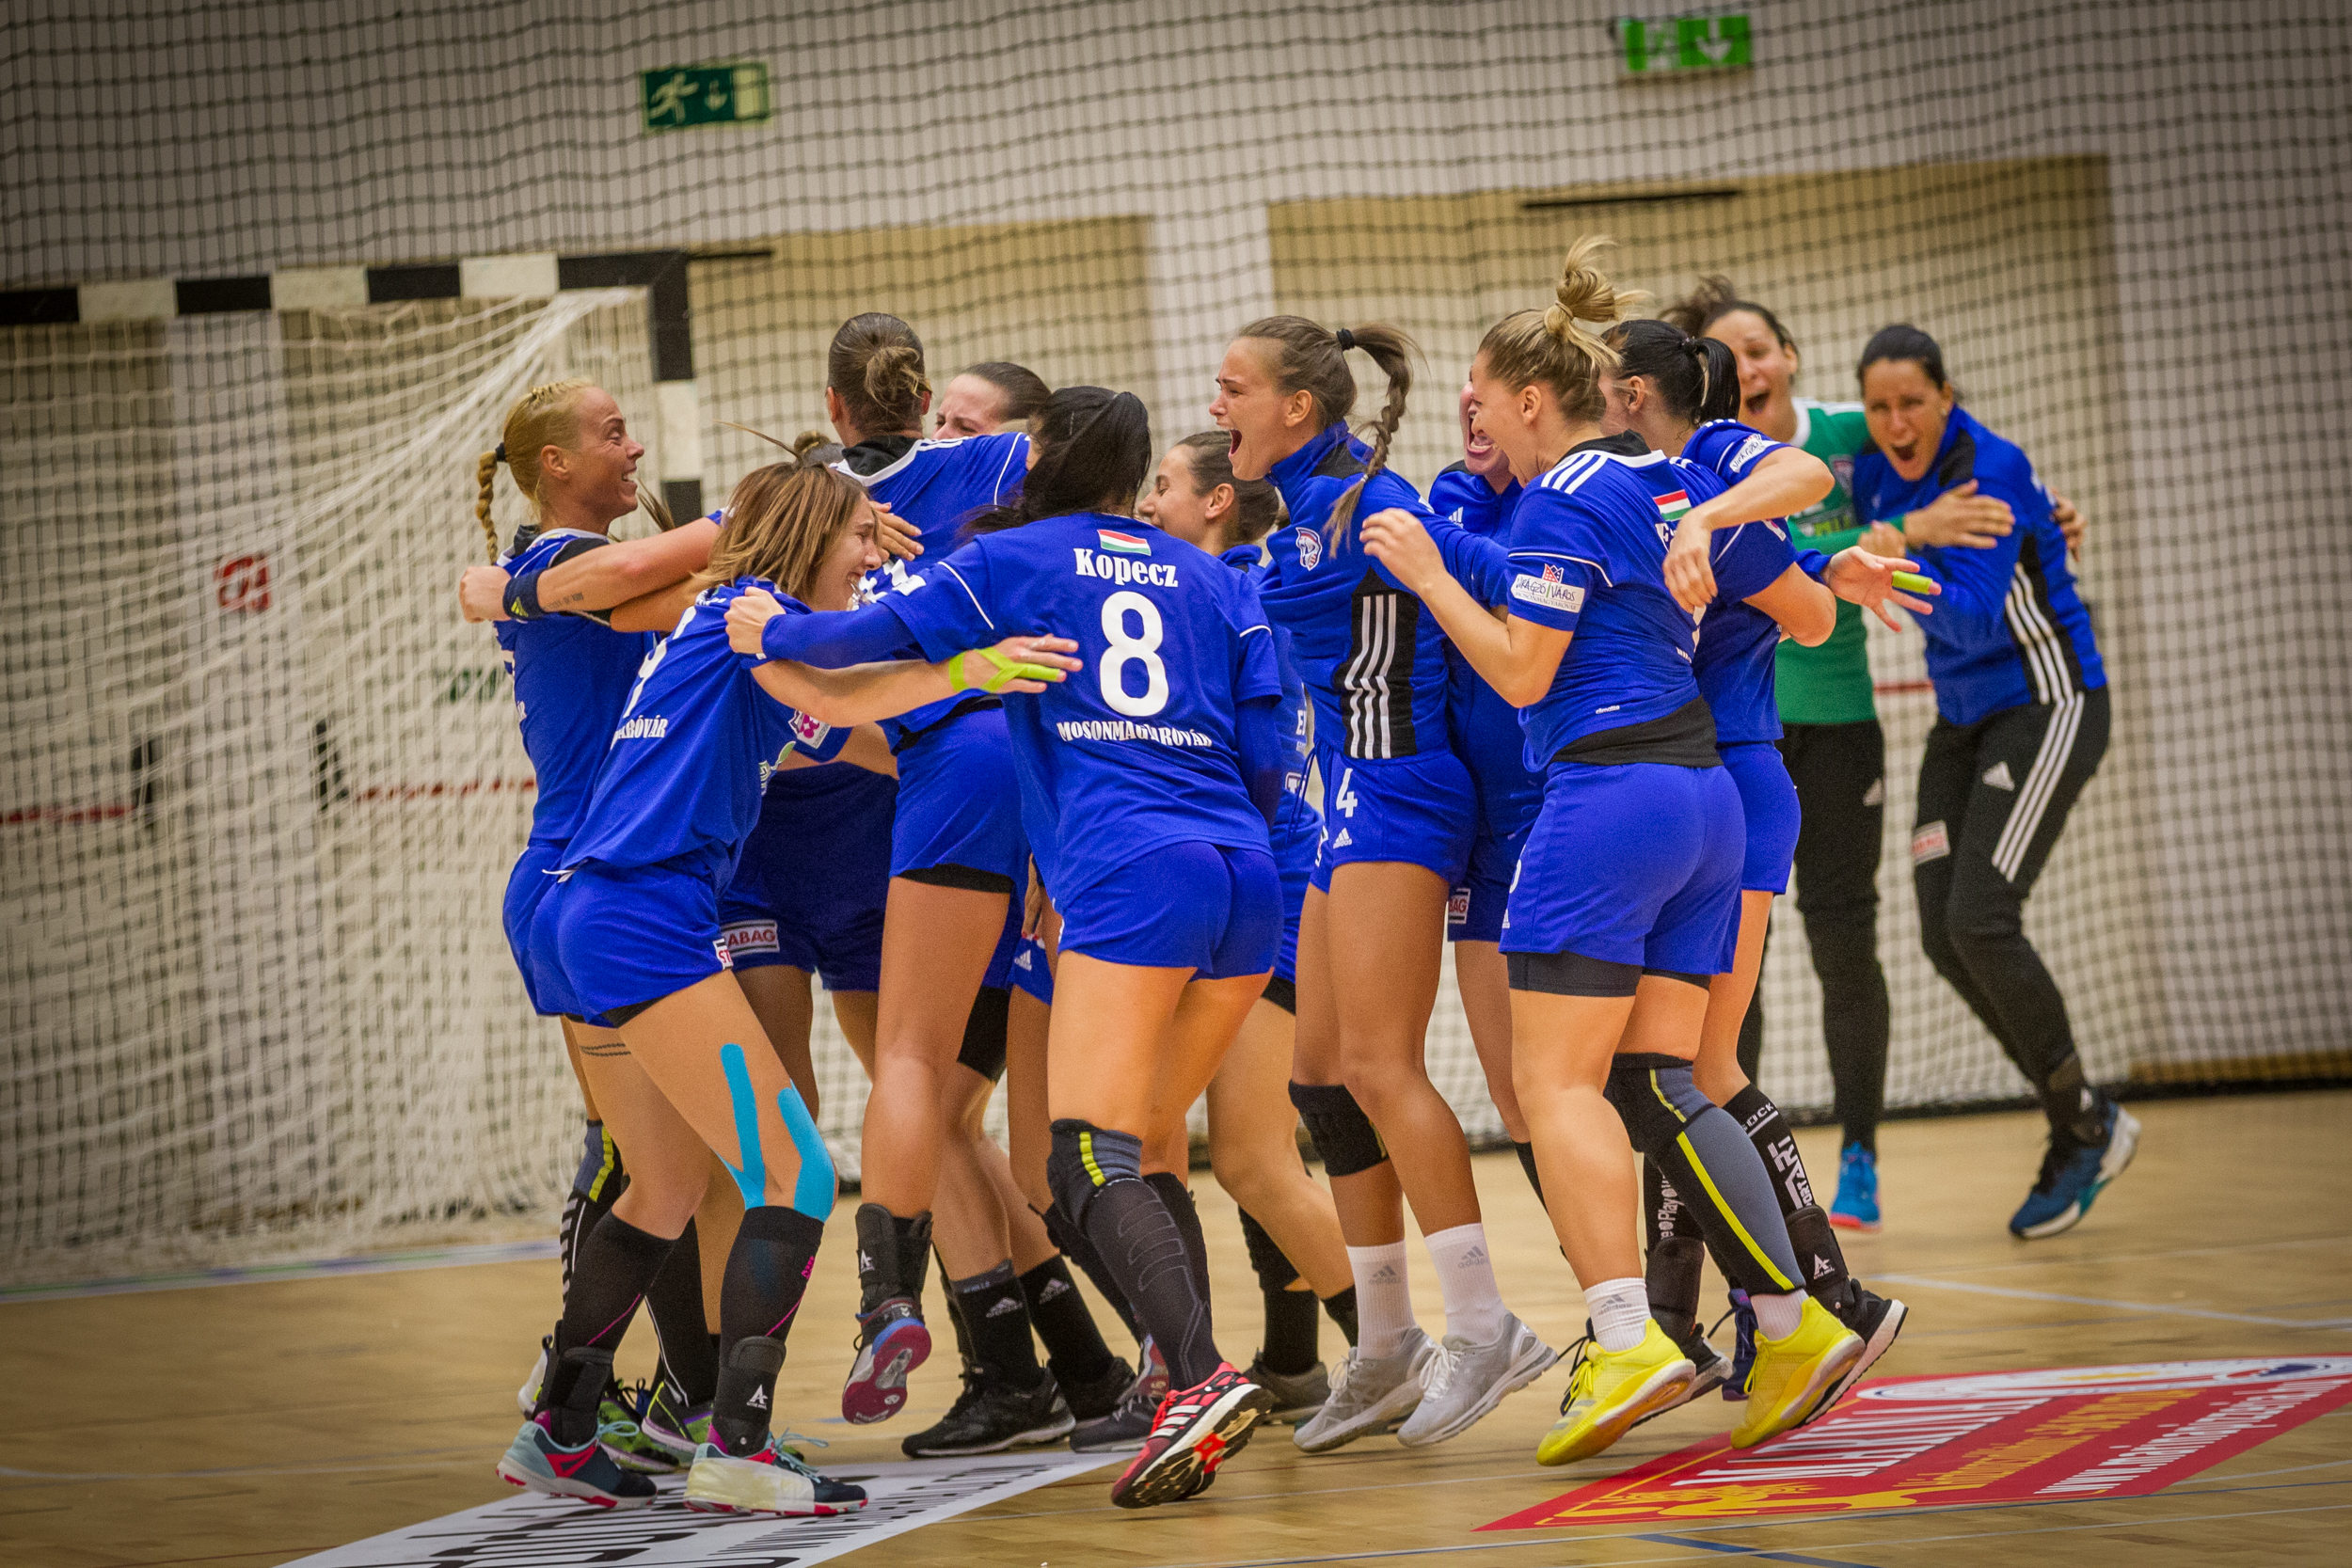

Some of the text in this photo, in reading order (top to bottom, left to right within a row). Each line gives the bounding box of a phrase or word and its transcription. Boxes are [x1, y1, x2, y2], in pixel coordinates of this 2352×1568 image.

[1073, 547, 1179, 588] Kopecz
[1100, 591, 1169, 717] 8
[617, 715, 669, 739] ARÓVÁR
[1336, 768, 1358, 818] 4
[727, 928, 776, 948] ABAG
